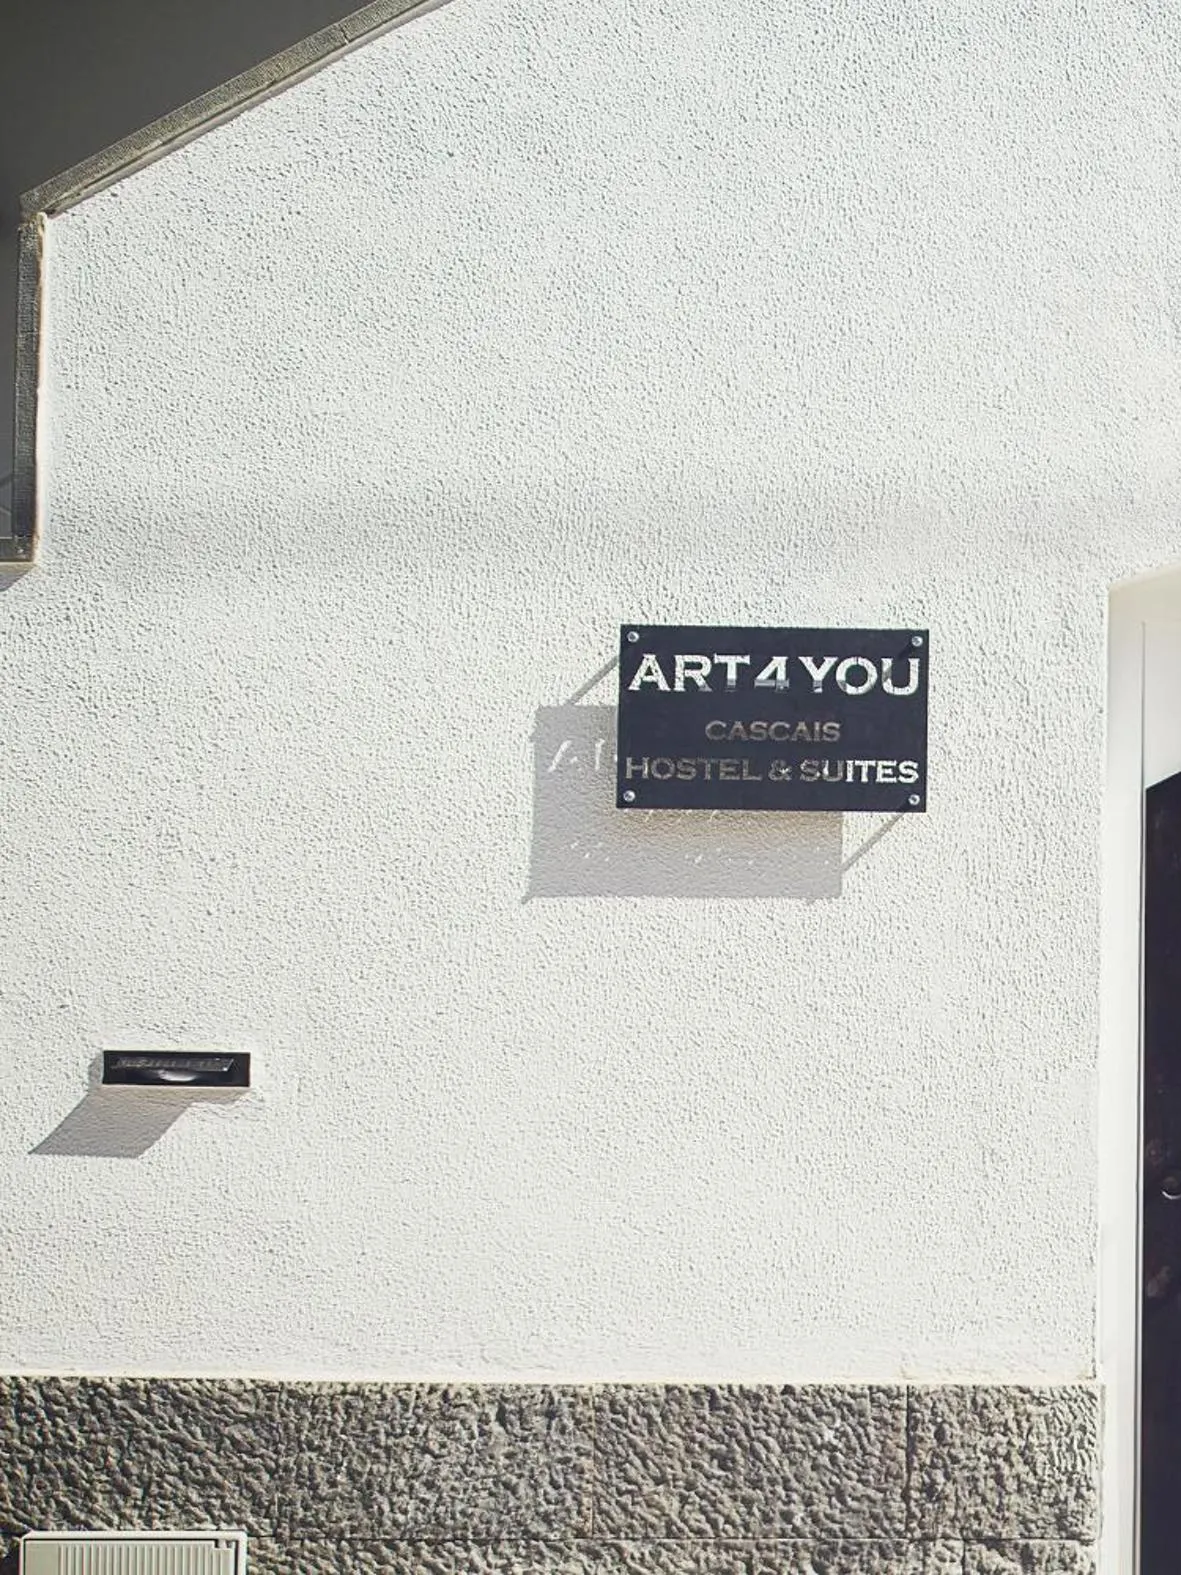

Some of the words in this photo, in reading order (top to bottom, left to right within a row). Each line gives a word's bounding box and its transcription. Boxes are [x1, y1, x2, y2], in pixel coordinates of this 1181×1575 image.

[705, 720, 842, 742] CASCAIS
[625, 756, 762, 781] HOSTEL
[768, 759, 793, 782] &
[799, 759, 920, 783] SUITES
